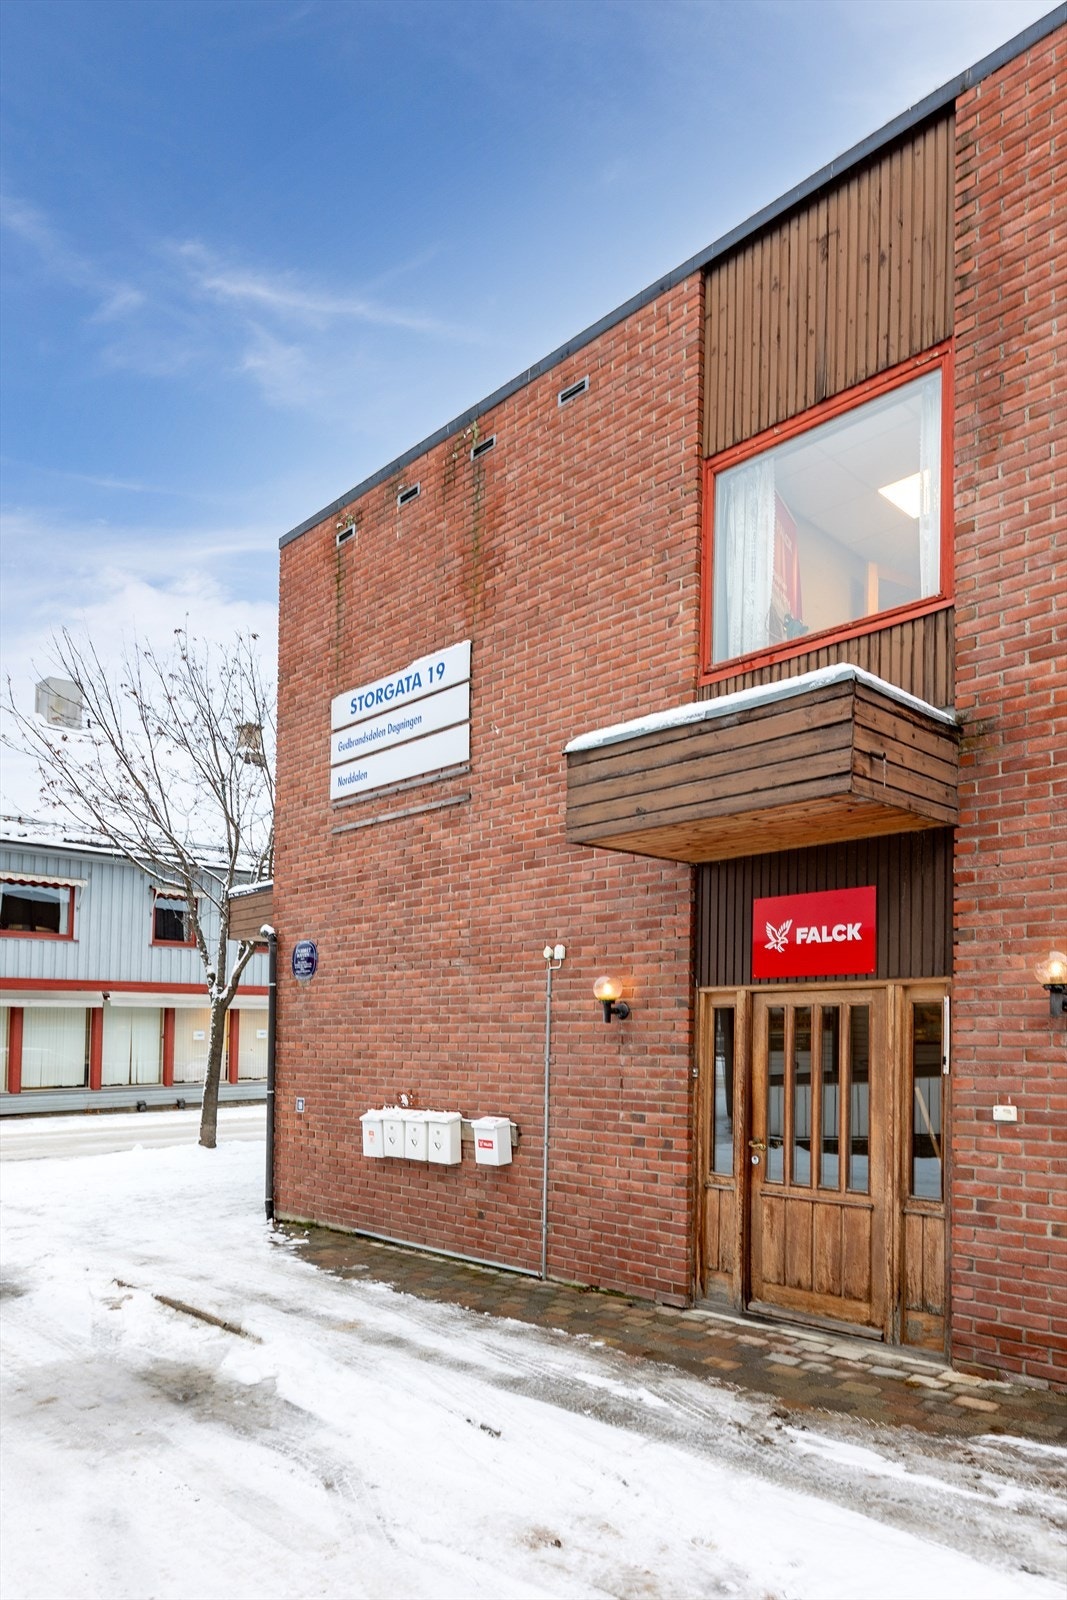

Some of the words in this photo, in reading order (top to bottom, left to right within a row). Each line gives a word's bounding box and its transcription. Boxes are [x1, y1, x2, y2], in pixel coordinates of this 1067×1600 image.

[350, 672, 422, 714] STORGATA
[428, 662, 445, 683] 19
[337, 769, 368, 787] Norddalen
[796, 922, 862, 945] FALCK
